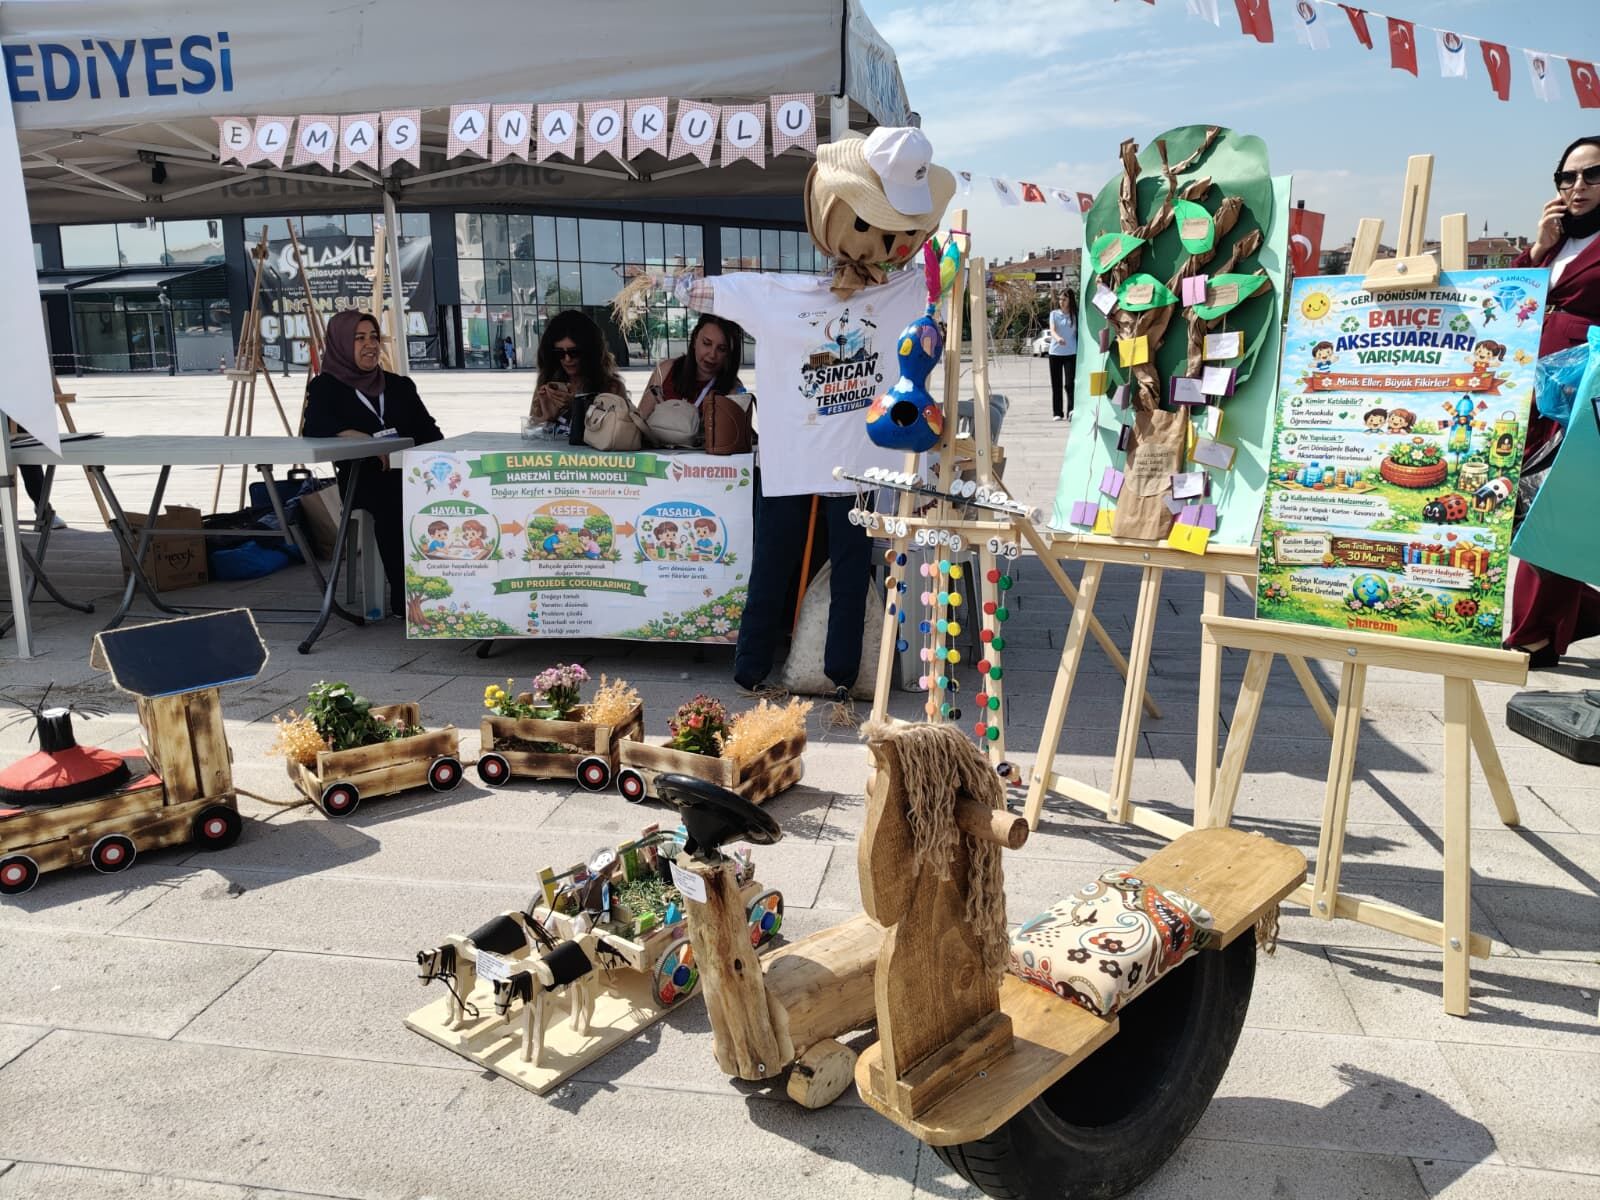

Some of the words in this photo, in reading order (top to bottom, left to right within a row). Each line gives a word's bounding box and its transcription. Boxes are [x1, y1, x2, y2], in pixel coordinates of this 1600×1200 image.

[231, 125, 409, 148] ELMAS
[459, 109, 803, 140] ANAOKULU
[1430, 290, 1467, 302] TEMALI
[1369, 308, 1441, 330] BAHÇE
[1336, 331, 1475, 352] AKSESUARLARI
[1357, 349, 1442, 366] YARIŞMASI
[1336, 378, 1360, 387] Minik
[1385, 378, 1412, 388] Büyük
[1415, 378, 1449, 387] Fikirler!
[506, 456, 552, 468] ELMAS
[558, 455, 635, 469] ANAOKULU
[507, 470, 550, 481] HAREZMİ
[554, 470, 587, 481] EĞİTİM
[590, 470, 627, 481] MODELİ
[491, 488, 518, 498] Doğayı
[521, 487, 544, 497] Keşfet
[554, 487, 579, 497] Düşün
[431, 506, 460, 516] HAYAL
[656, 507, 701, 518] TASARLA
[916, 530, 925, 545] 5
[929, 530, 936, 545] 6
[989, 539, 998, 554] 9
[1004, 545, 1018, 557] 10
[1347, 551, 1360, 561] 30
[1362, 552, 1385, 563] Mart
[511, 581, 523, 589] BU
[526, 580, 566, 588] PROJEDE
[569, 580, 631, 591] ÇOCUKLARIMIZ
